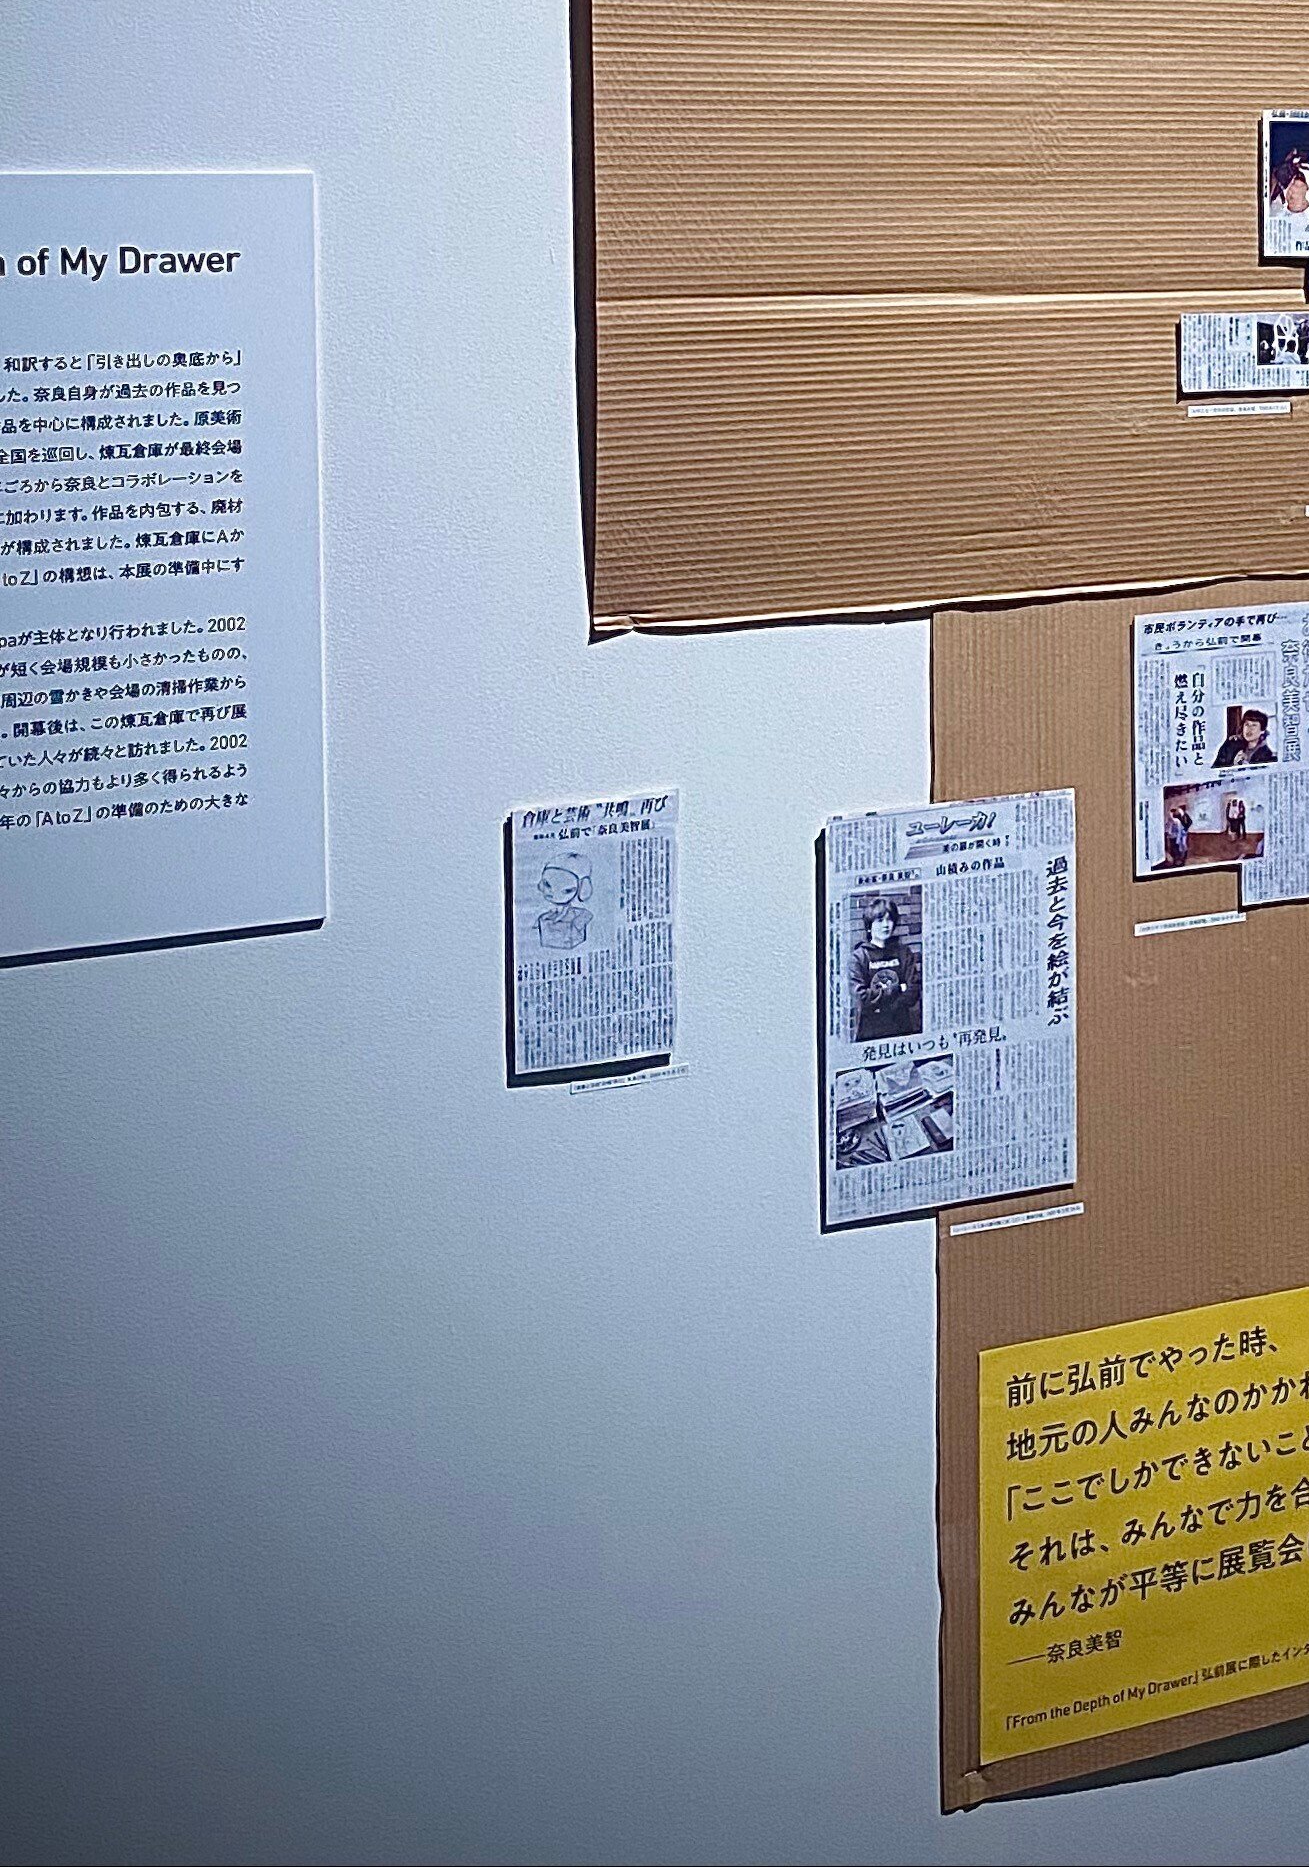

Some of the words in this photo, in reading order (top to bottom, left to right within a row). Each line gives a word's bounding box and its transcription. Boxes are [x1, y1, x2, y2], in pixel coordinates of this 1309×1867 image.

[17, 247, 49, 276] of
[60, 247, 108, 281] My
[119, 246, 241, 274] Drawer
[3, 350, 241, 373] 和訳すると「引き出しの奥底から」
[0, 409, 242, 434] 品を中心に構成されました。原美術
[0, 469, 243, 494] ごろから奈良とコラボレーションを
[1281, 639, 1300, 762] 奈良美智展
[936, 857, 1005, 876] 山積みの作品
[1046, 855, 1070, 1027] 過去と今を絵が結ぶ
[1006, 1326, 1279, 1408] 前に弘前でやった時、
[1050, 1704, 1070, 1720] the
[1073, 1694, 1110, 1714] Depth
[1113, 1689, 1125, 1704] of
[1127, 1686, 1146, 1701] My
